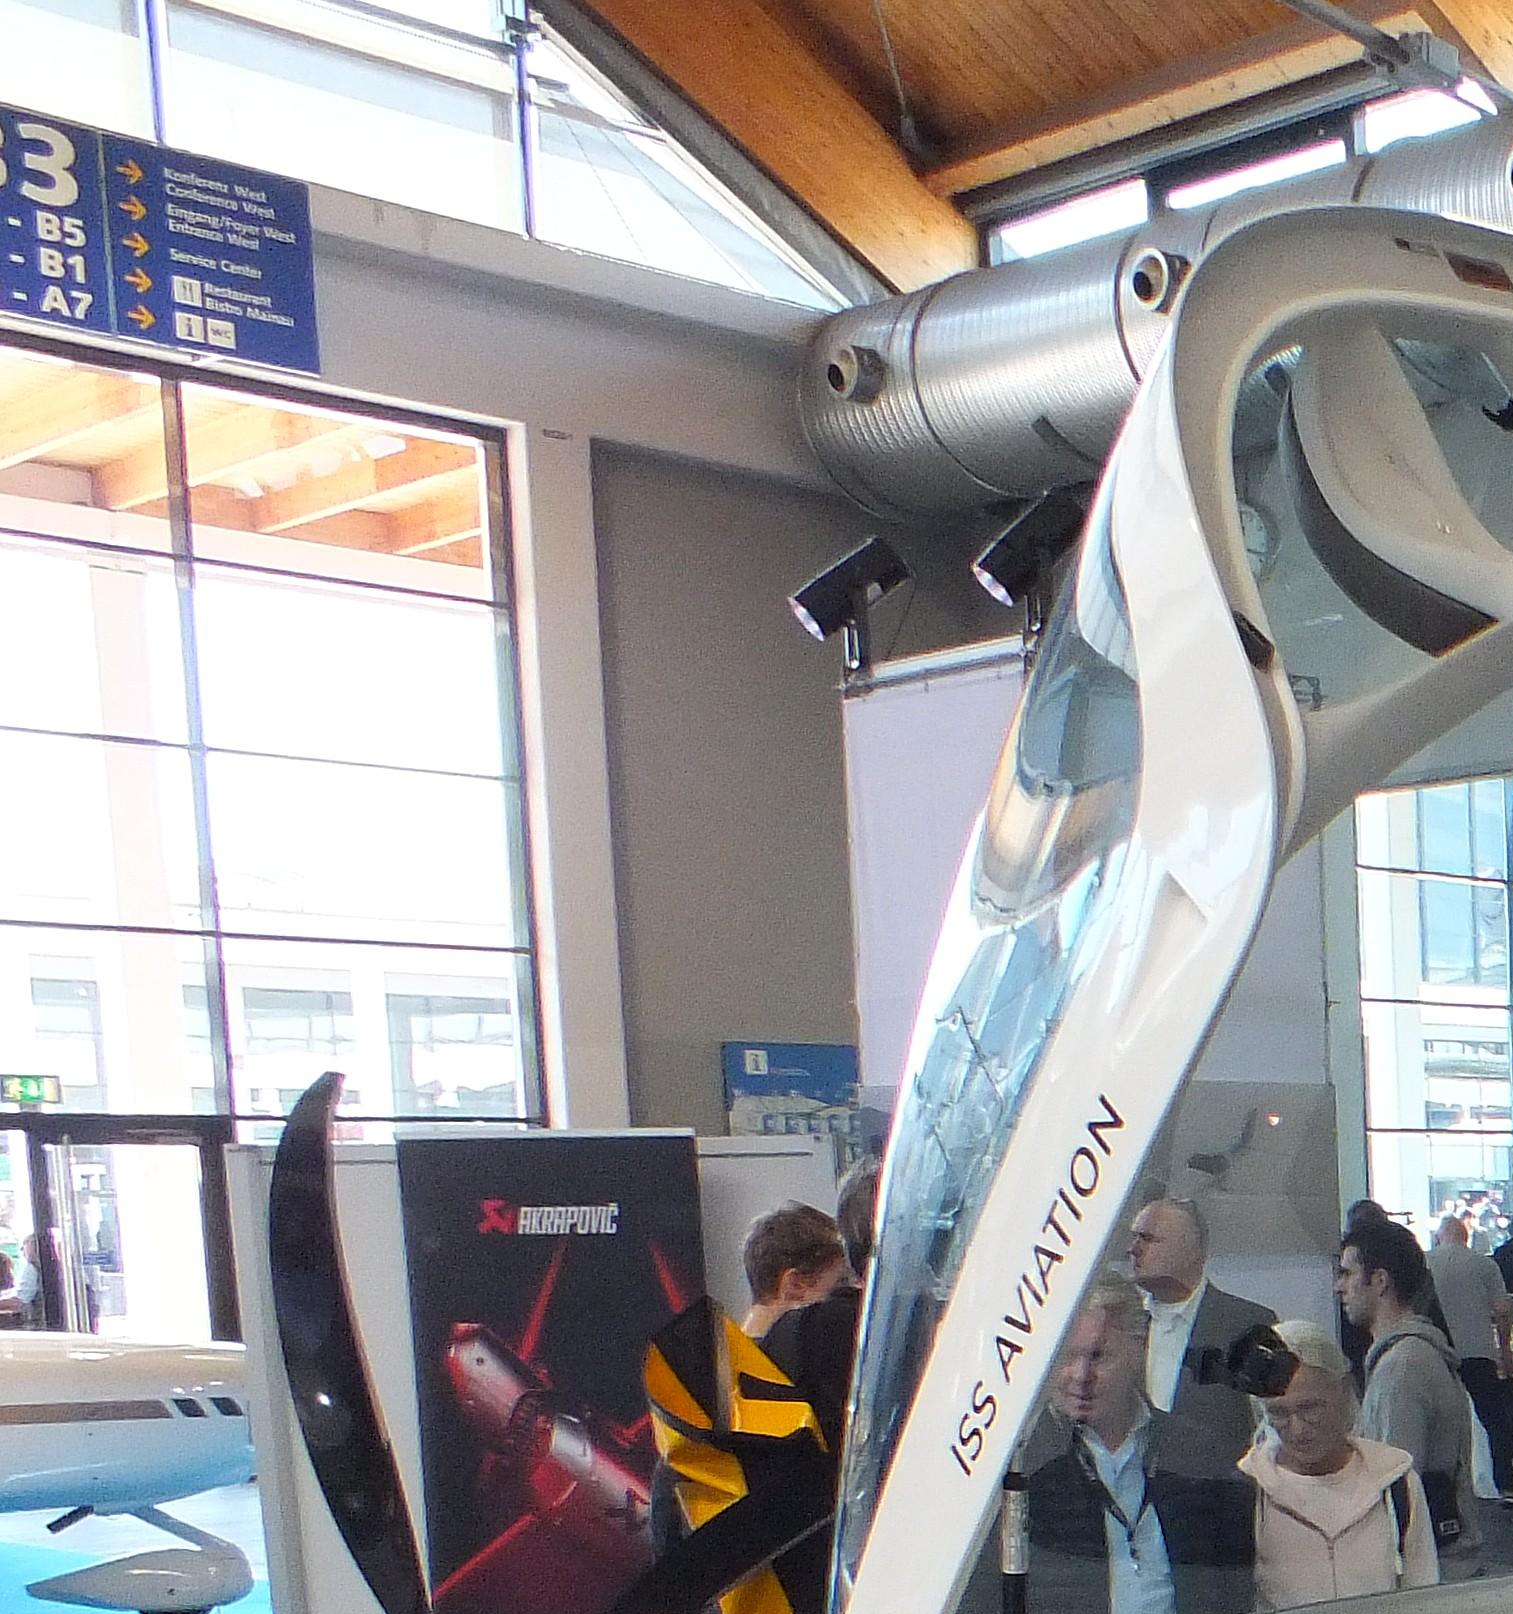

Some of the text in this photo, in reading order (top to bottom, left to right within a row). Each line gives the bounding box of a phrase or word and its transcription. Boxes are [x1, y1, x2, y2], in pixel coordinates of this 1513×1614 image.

[0, 122, 79, 207] 3
[36, 210, 87, 247] B5
[40, 247, 86, 284] B1
[41, 285, 93, 320] A7
[951, 1093, 1126, 1477] ISS AVIATION
